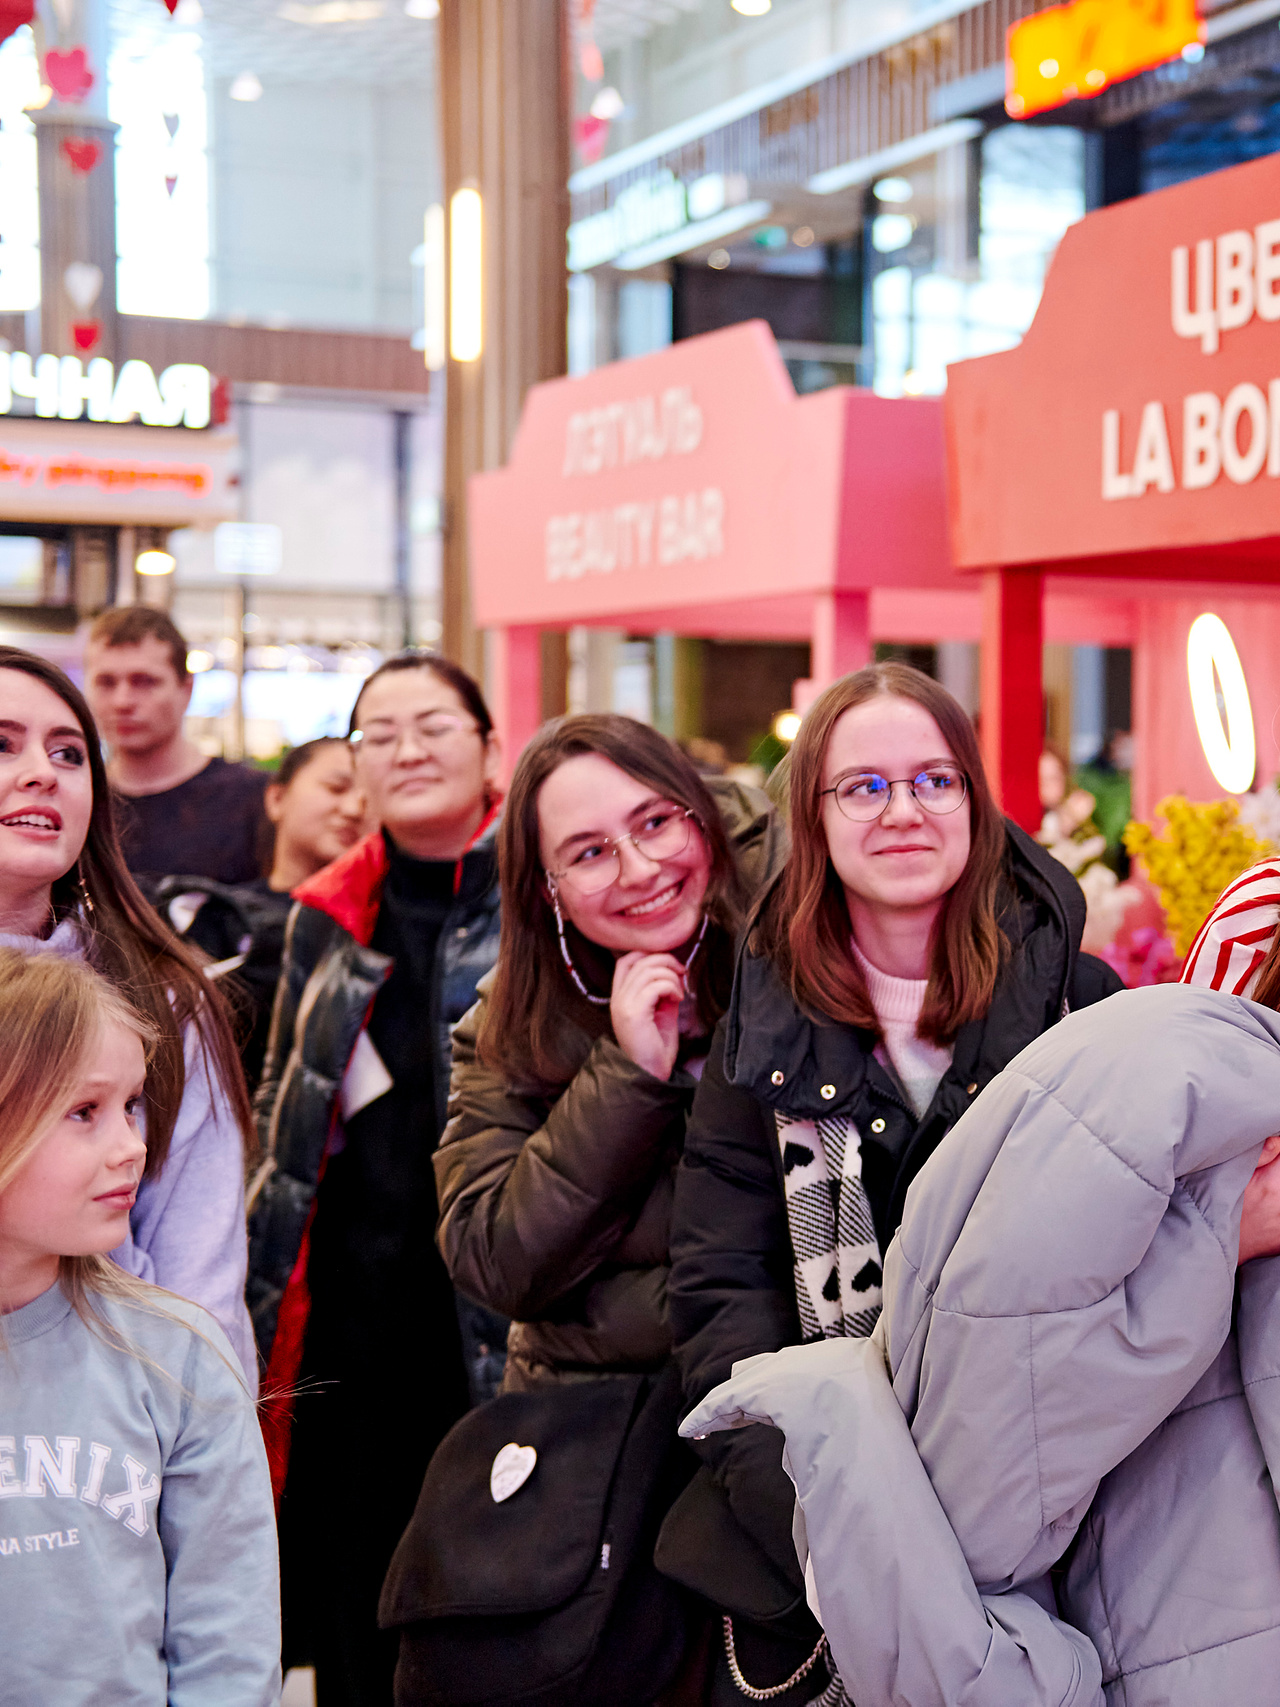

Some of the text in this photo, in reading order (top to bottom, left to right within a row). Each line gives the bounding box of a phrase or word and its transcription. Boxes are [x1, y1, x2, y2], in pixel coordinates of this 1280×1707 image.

[0, 350, 211, 430] ЧНАЯ
[1102, 401, 1175, 500] LA
[546, 487, 724, 582] BEAUTY BAR
[24, 1528, 80, 1553] STYLE
